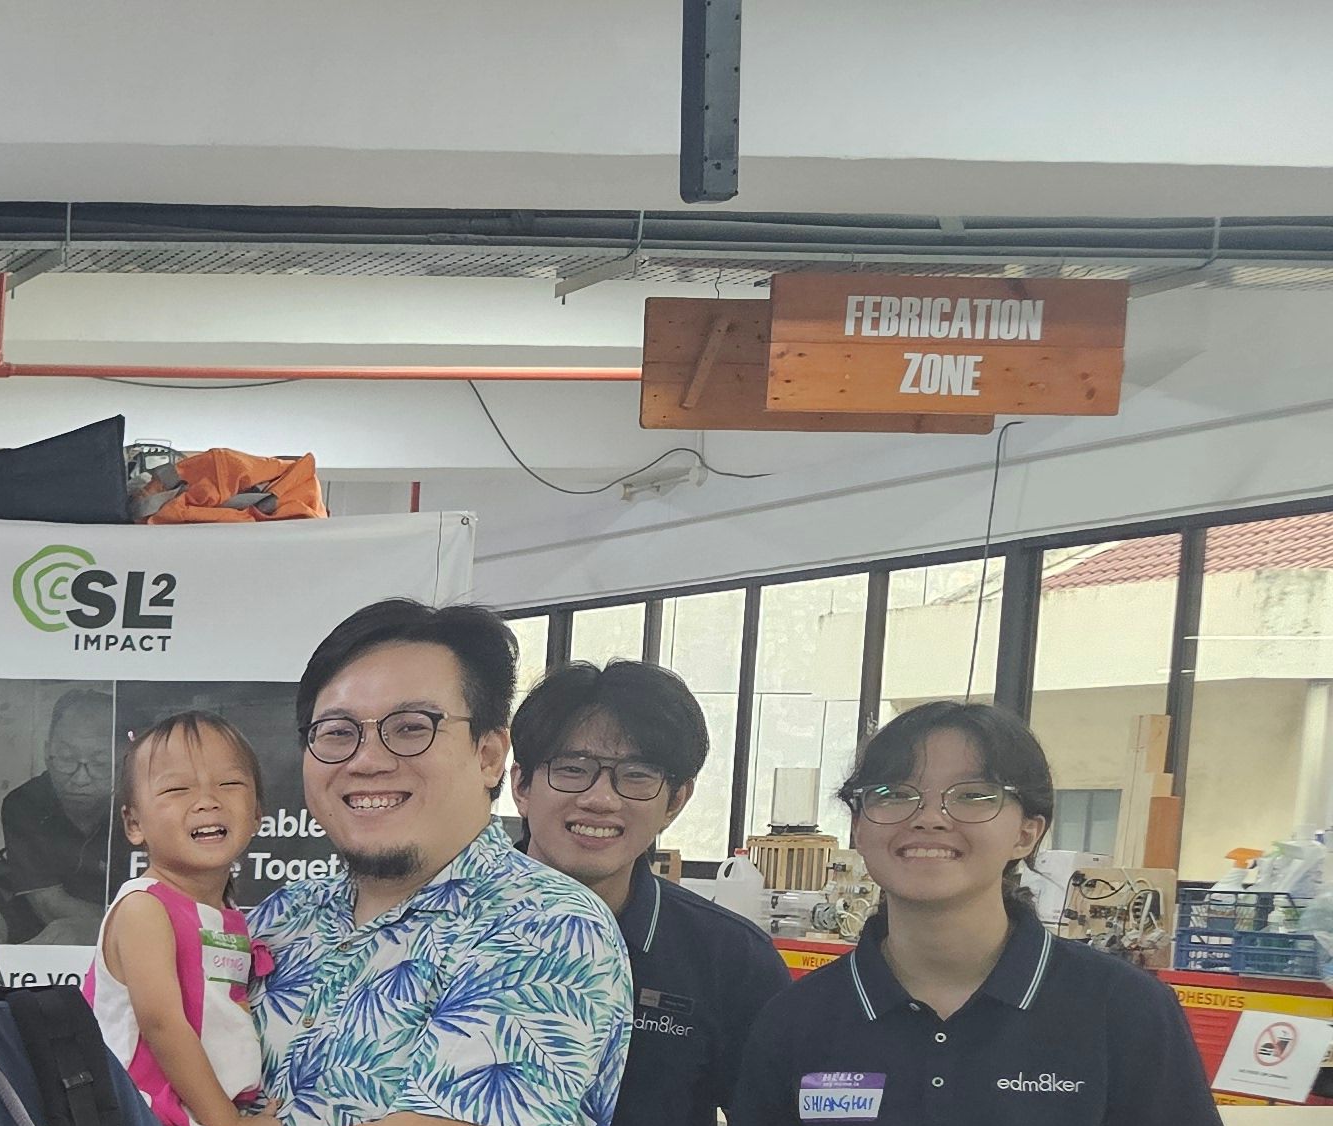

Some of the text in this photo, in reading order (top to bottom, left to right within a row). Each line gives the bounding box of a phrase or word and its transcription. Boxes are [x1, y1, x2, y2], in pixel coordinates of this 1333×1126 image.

[844, 295, 1045, 341] FEBRICATION
[899, 352, 983, 396] ZONE
[74, 633, 172, 652] IMPACT
[251, 808, 327, 838] able
[46, 972, 88, 988] yo
[821, 1072, 865, 1082] HELLO
